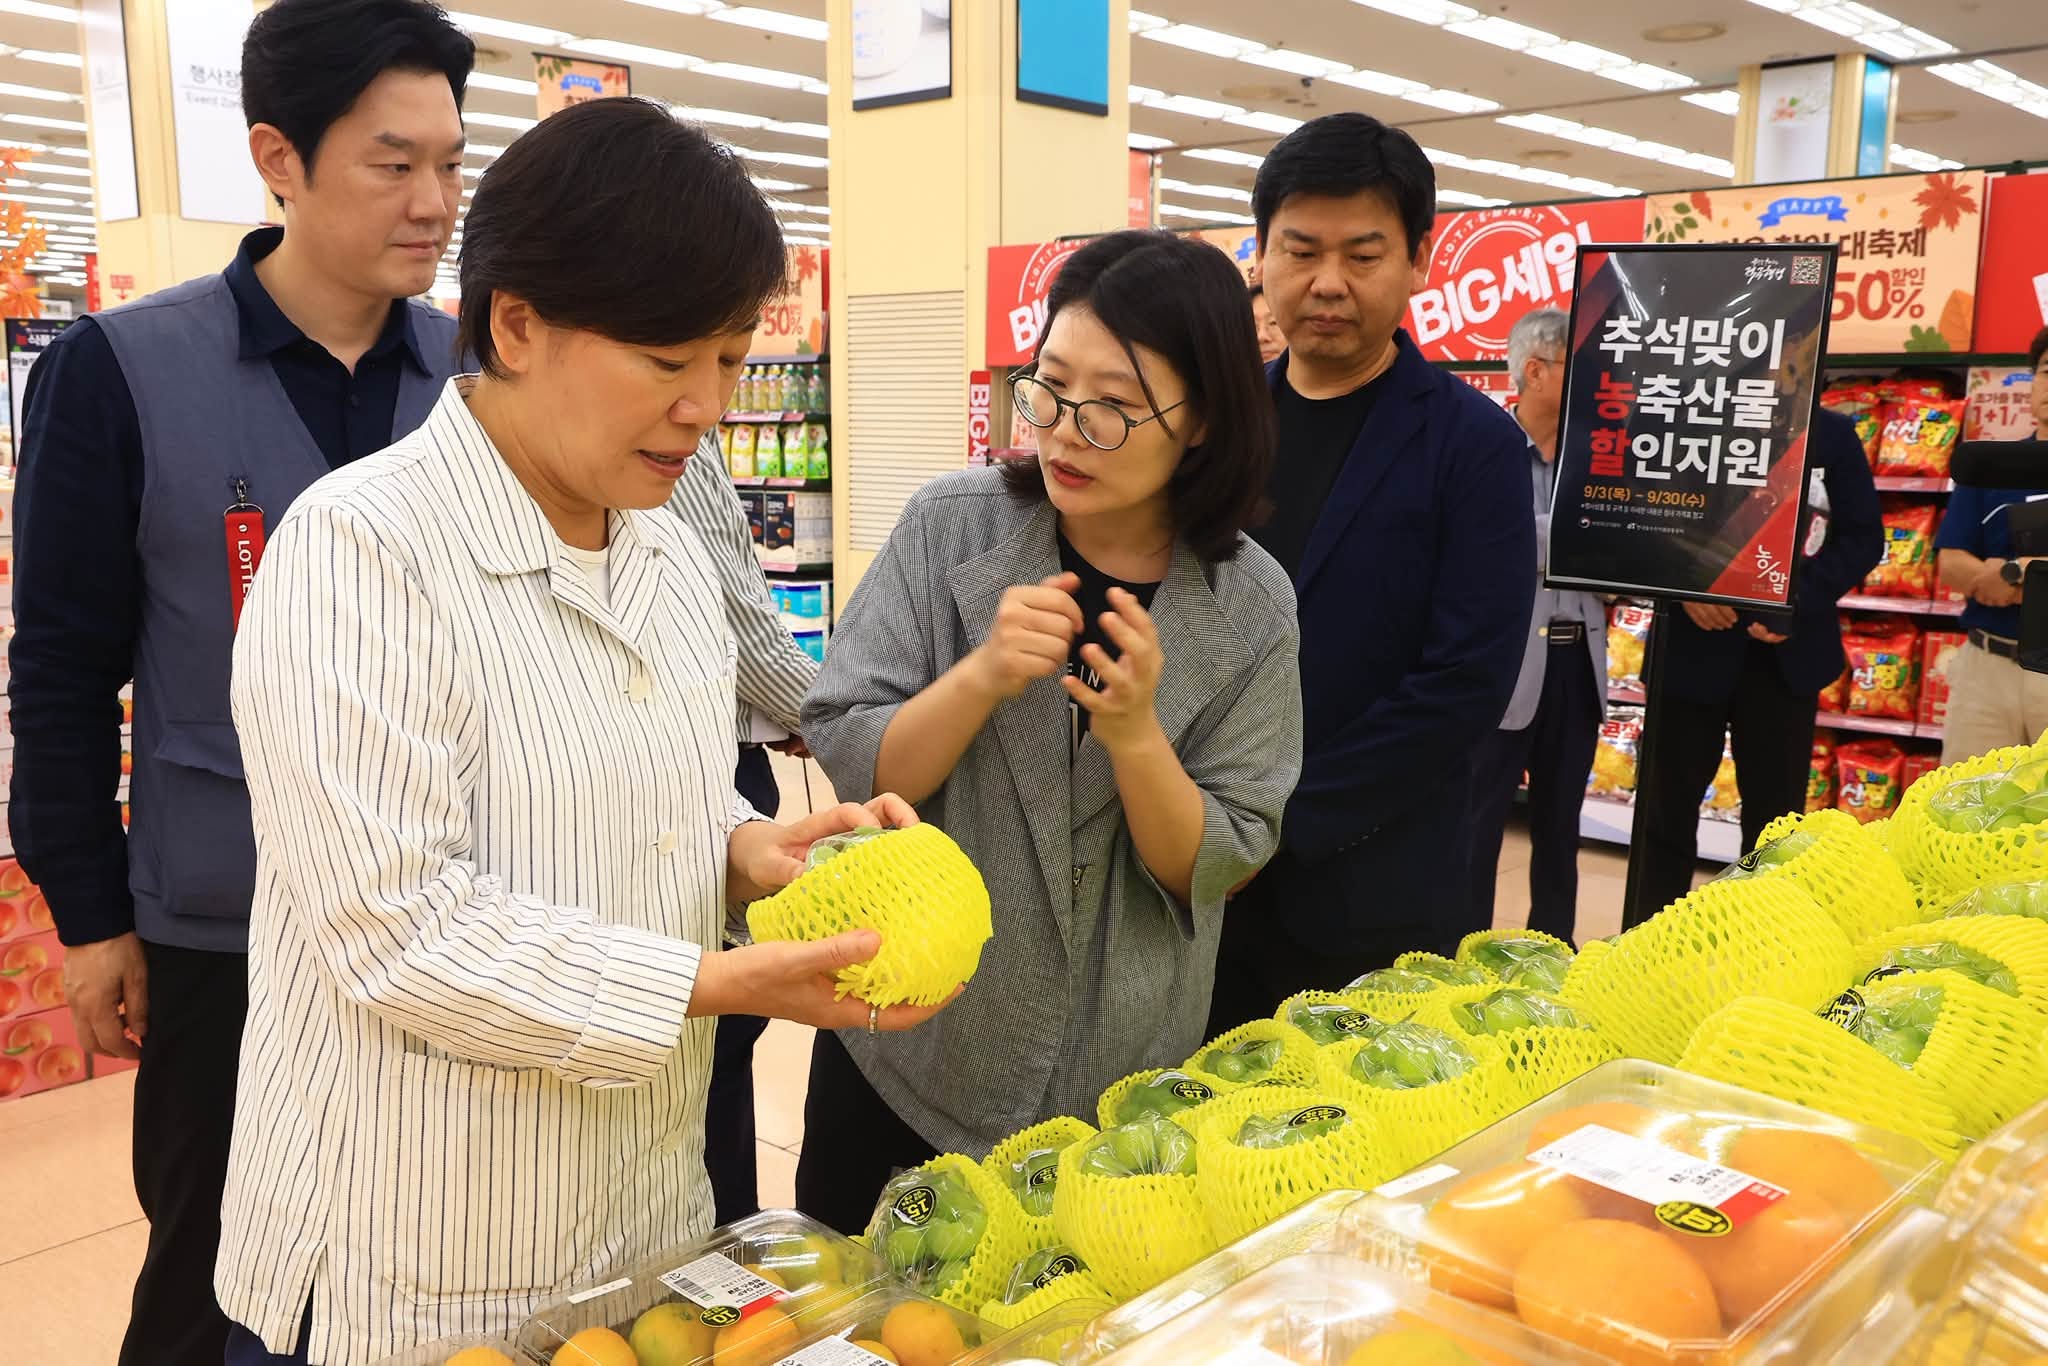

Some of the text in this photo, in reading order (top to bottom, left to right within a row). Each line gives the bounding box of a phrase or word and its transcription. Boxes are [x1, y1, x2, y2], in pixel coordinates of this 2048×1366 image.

[1777, 199, 1835, 213] HAPPY
[1841, 228, 1927, 259] 대축제
[1890, 268, 1925, 287] 할인
[1833, 270, 1925, 321] 50%
[1600, 315, 1785, 369] 추석맞이
[1465, 376, 1490, 390] 1+1
[1594, 371, 1779, 429] 농축산물
[1590, 428, 1771, 488] 할인지원
[1583, 485, 1632, 502] 9/3(목)
[1647, 490, 1705, 508] 9/30(수)
[907, 1198, 929, 1218] 15
[711, 1309, 737, 1324] 10
